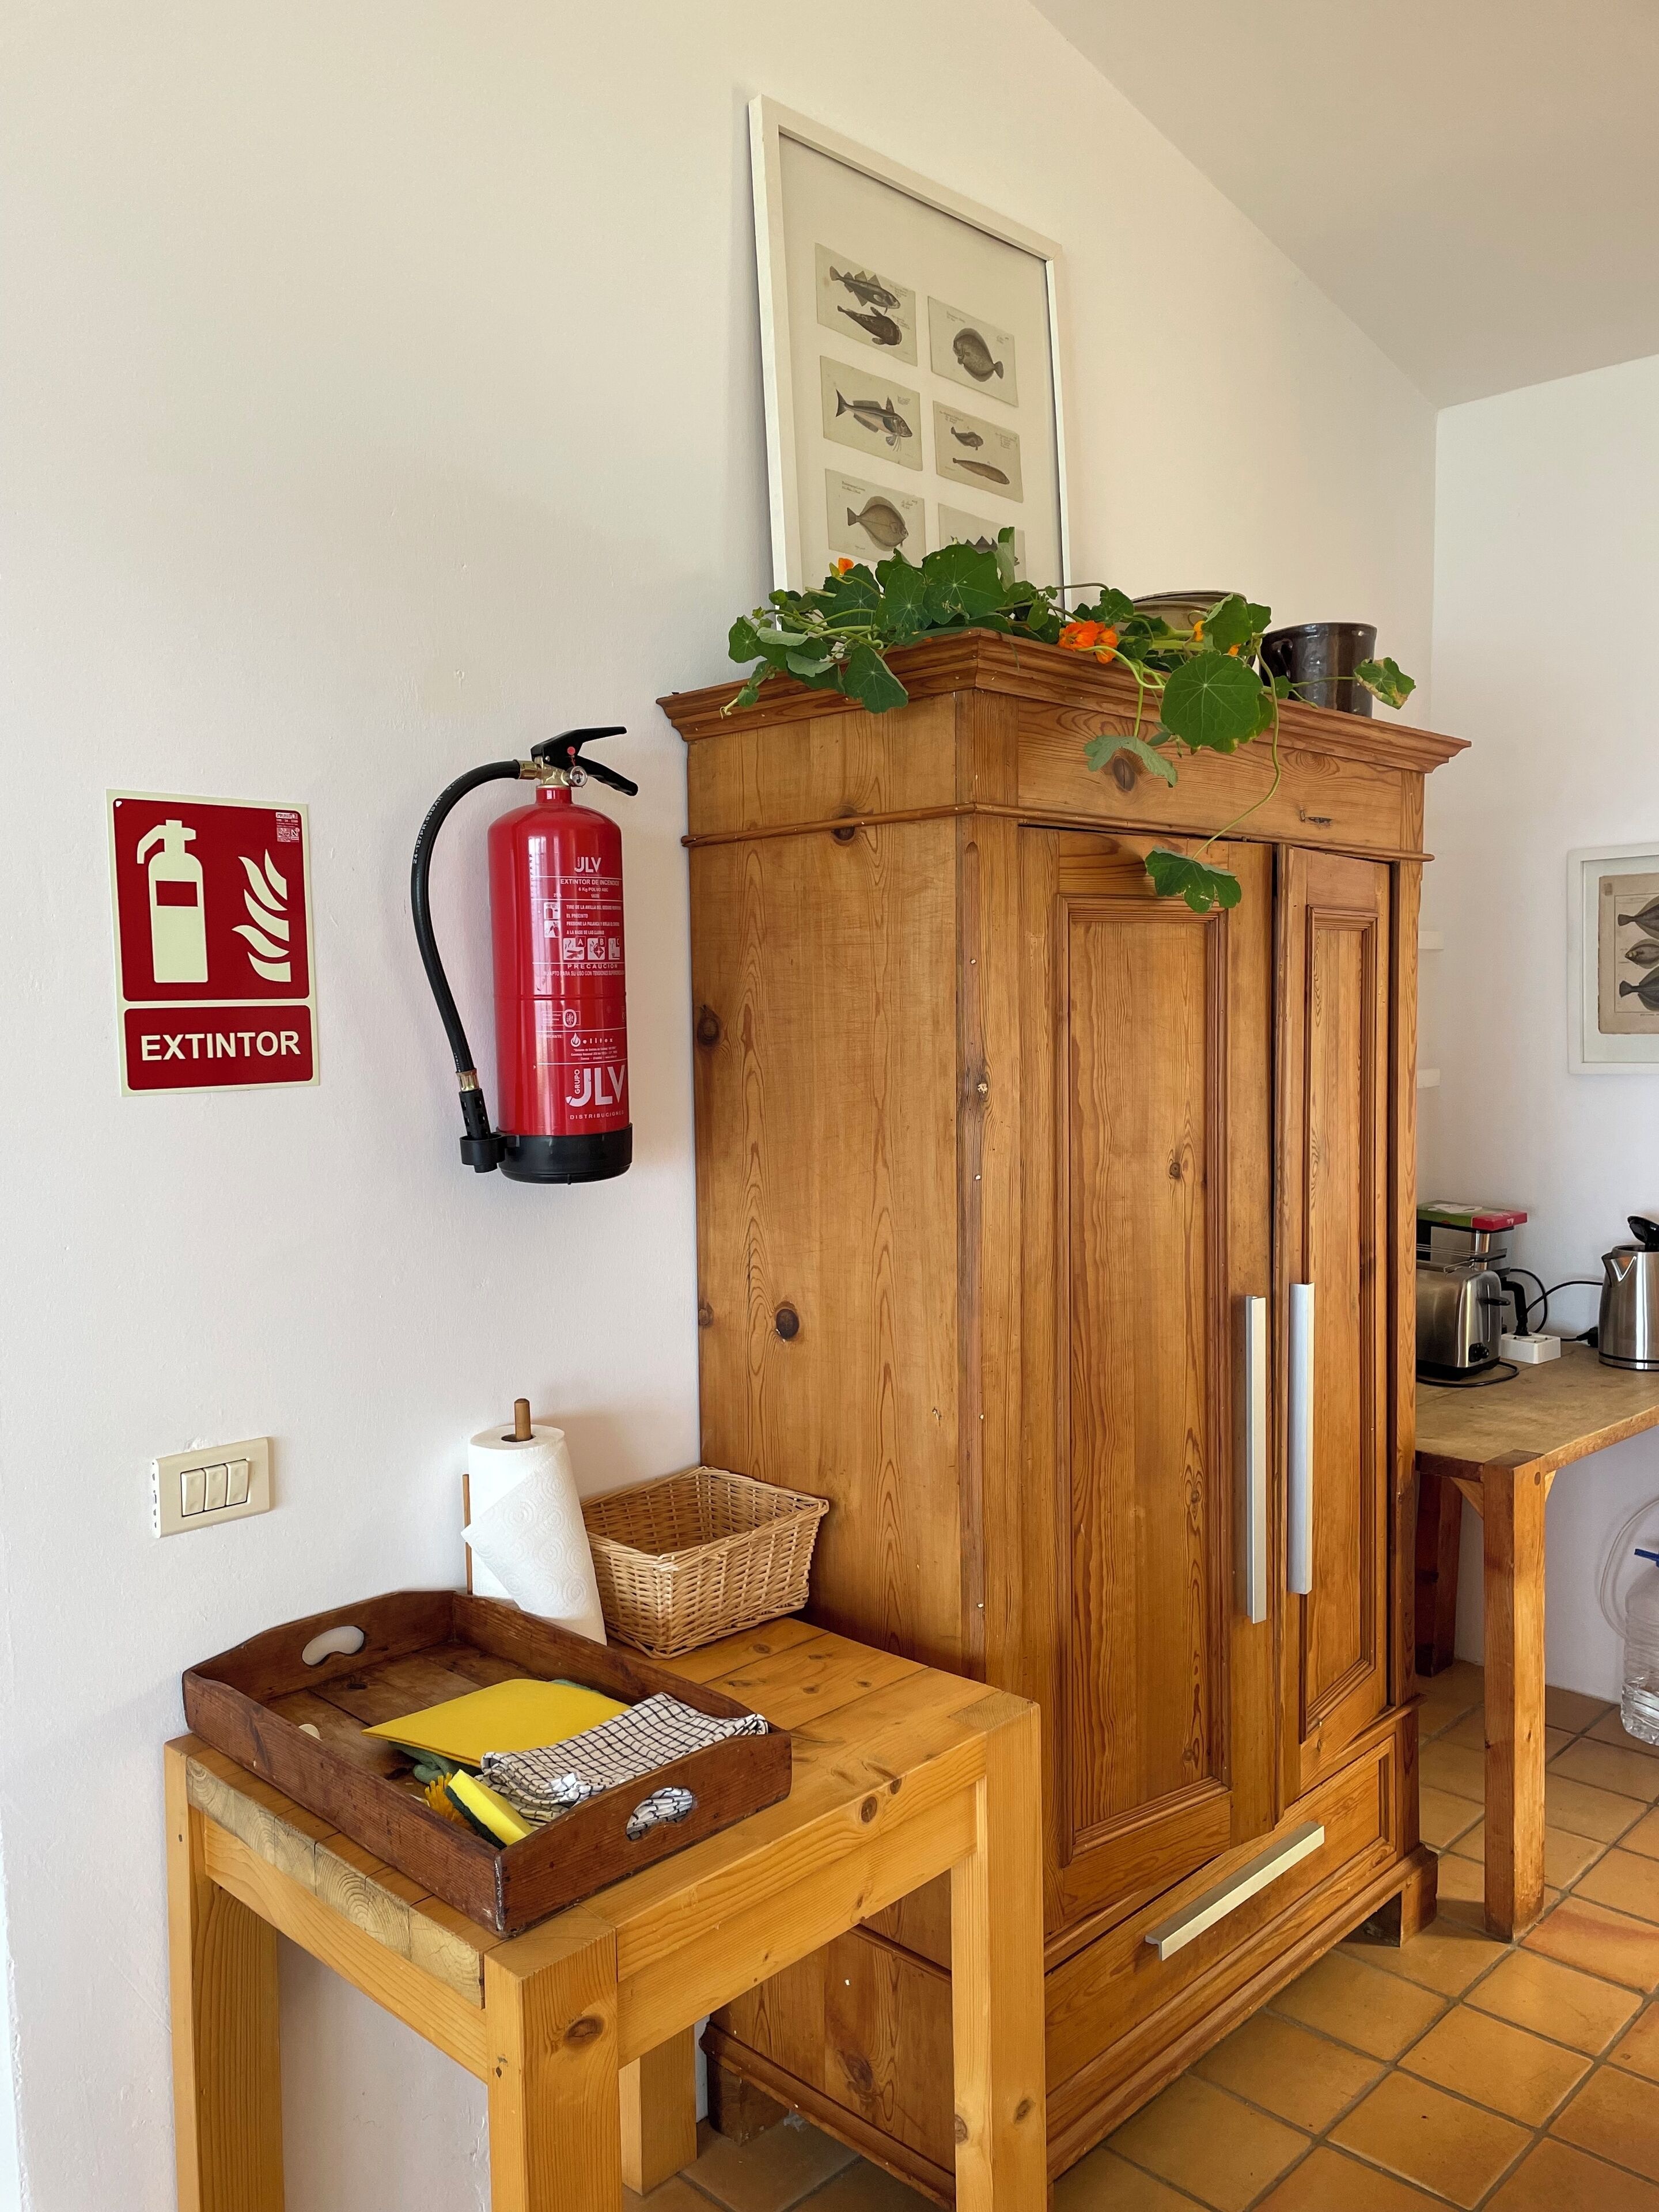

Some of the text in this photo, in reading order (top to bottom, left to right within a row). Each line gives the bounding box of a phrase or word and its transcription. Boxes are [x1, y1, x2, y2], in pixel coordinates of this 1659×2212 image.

[574, 857, 601, 873] JLV
[141, 1031, 301, 1060] EXTINTOR
[565, 1065, 626, 1107] JLV
[570, 1110, 624, 1120] DISTRIBUCIONES
